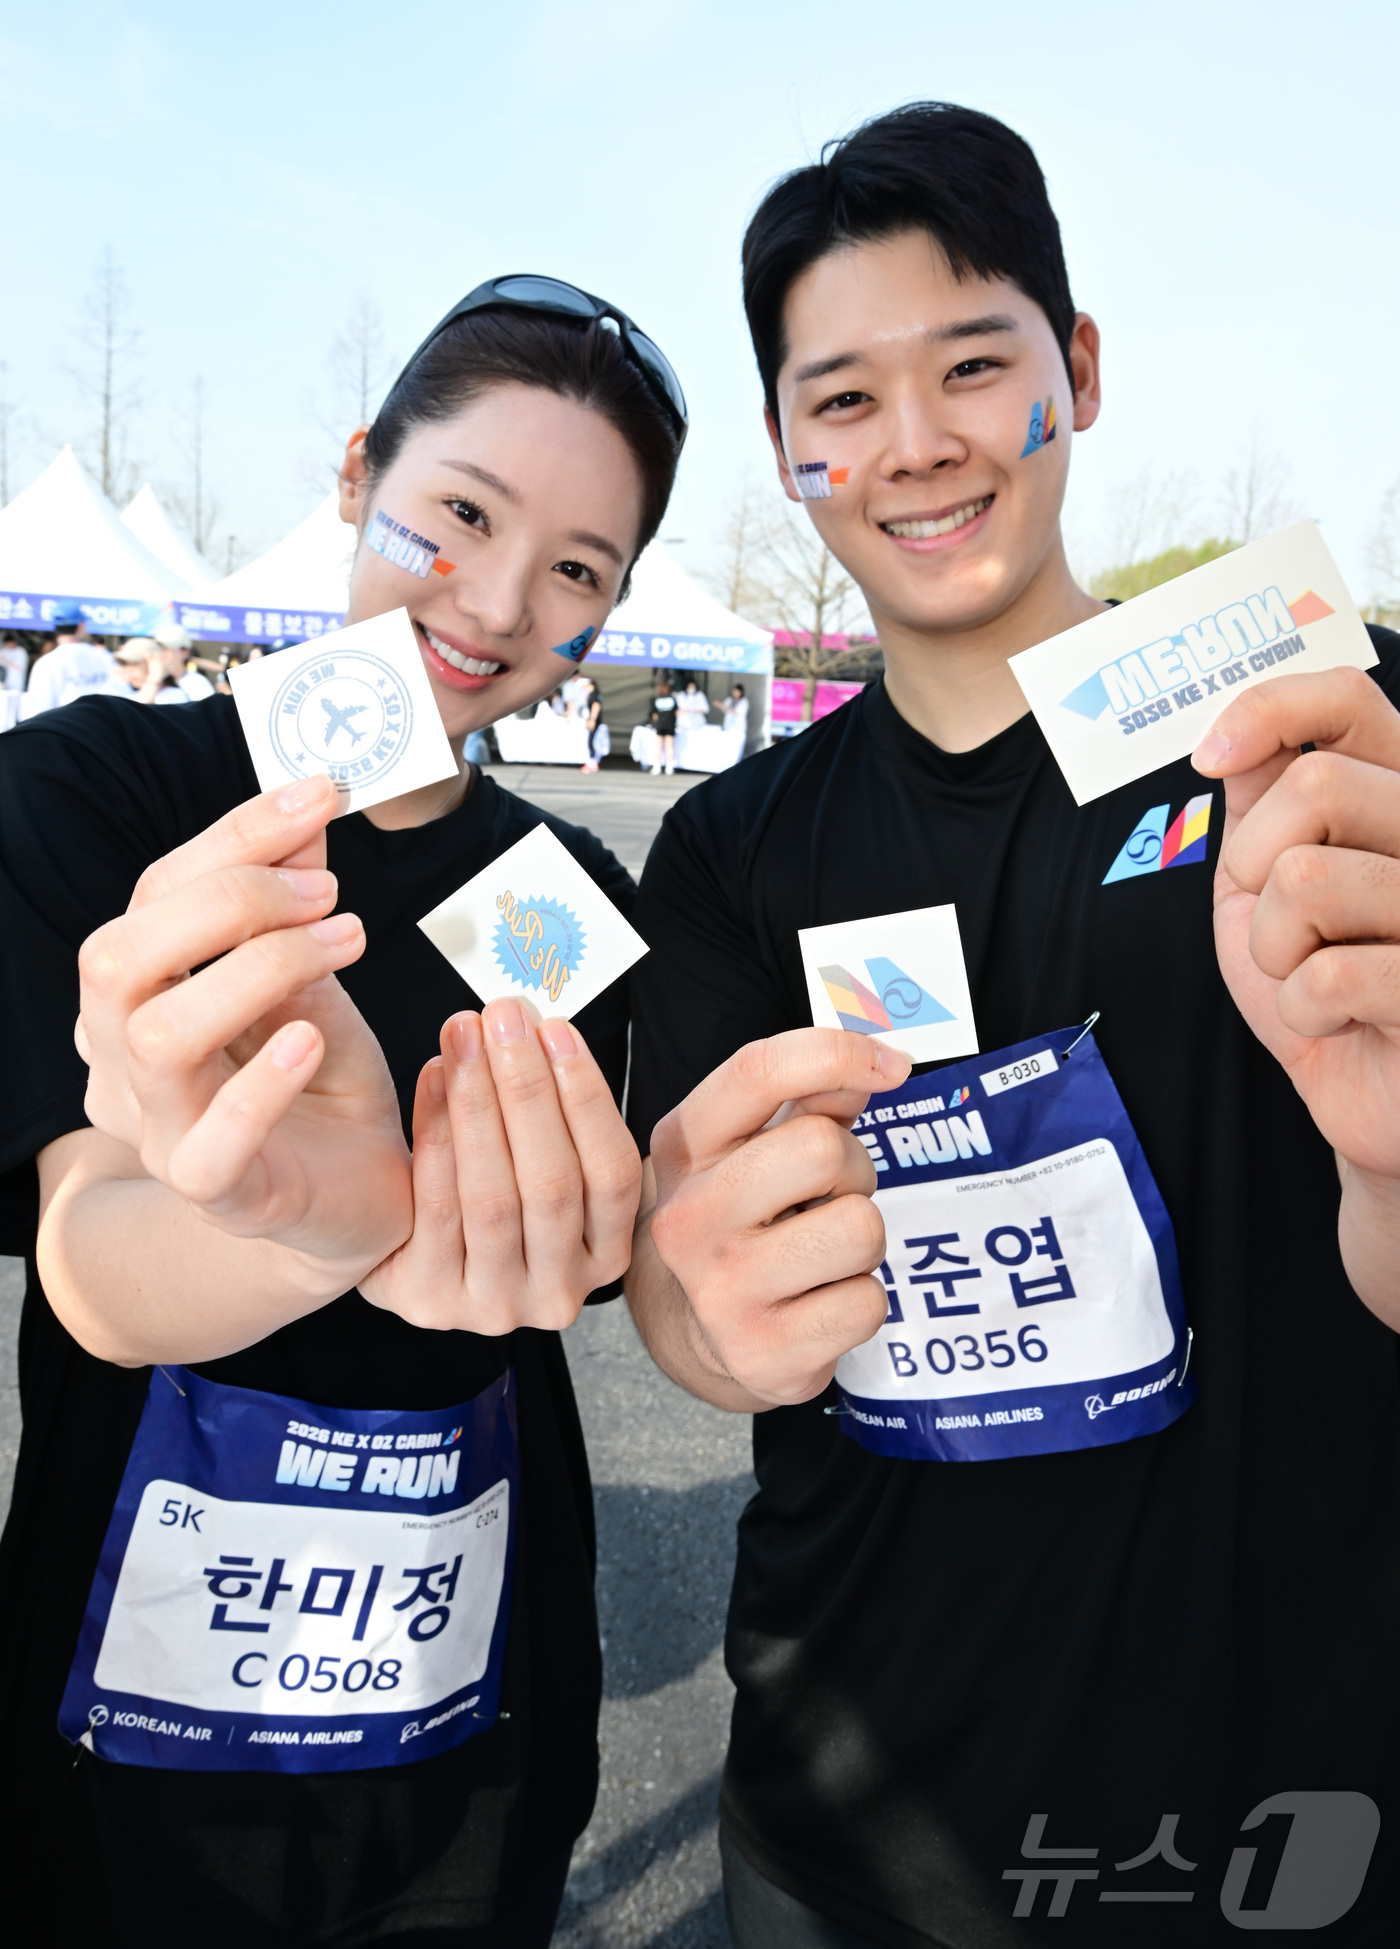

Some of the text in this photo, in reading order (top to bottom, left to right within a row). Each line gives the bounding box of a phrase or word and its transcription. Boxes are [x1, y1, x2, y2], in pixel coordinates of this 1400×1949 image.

[383, 532, 436, 579] RUN
[410, 533, 440, 554] CABIN
[651, 638, 745, 663] D GROUP
[999, 1059, 1042, 1086] B-030
[860, 1111, 876, 1127] X
[875, 1107, 898, 1123] OZ
[897, 1095, 946, 1119] CABIN
[885, 1110, 993, 1169] RUN
[956, 1146, 1107, 1193] EMERGENCY NUMBER +82 10-9180-0752
[887, 1324, 1049, 1378] B 0356
[1111, 1368, 1177, 1406] BOEING
[286, 1420, 442, 1450] 2026 KE X OZ CABIN
[886, 1416, 908, 1430] AIR
[935, 1407, 1044, 1430] ASIANA AIRLINES
[275, 1440, 461, 1499] WE RUN
[158, 1498, 206, 1533] 5K
[203, 1554, 464, 1643] 한미정
[231, 1651, 402, 1693] C 0508
[113, 1711, 213, 1741] KOREAN AIR
[248, 1730, 364, 1745] ASIANA AIRLINES
